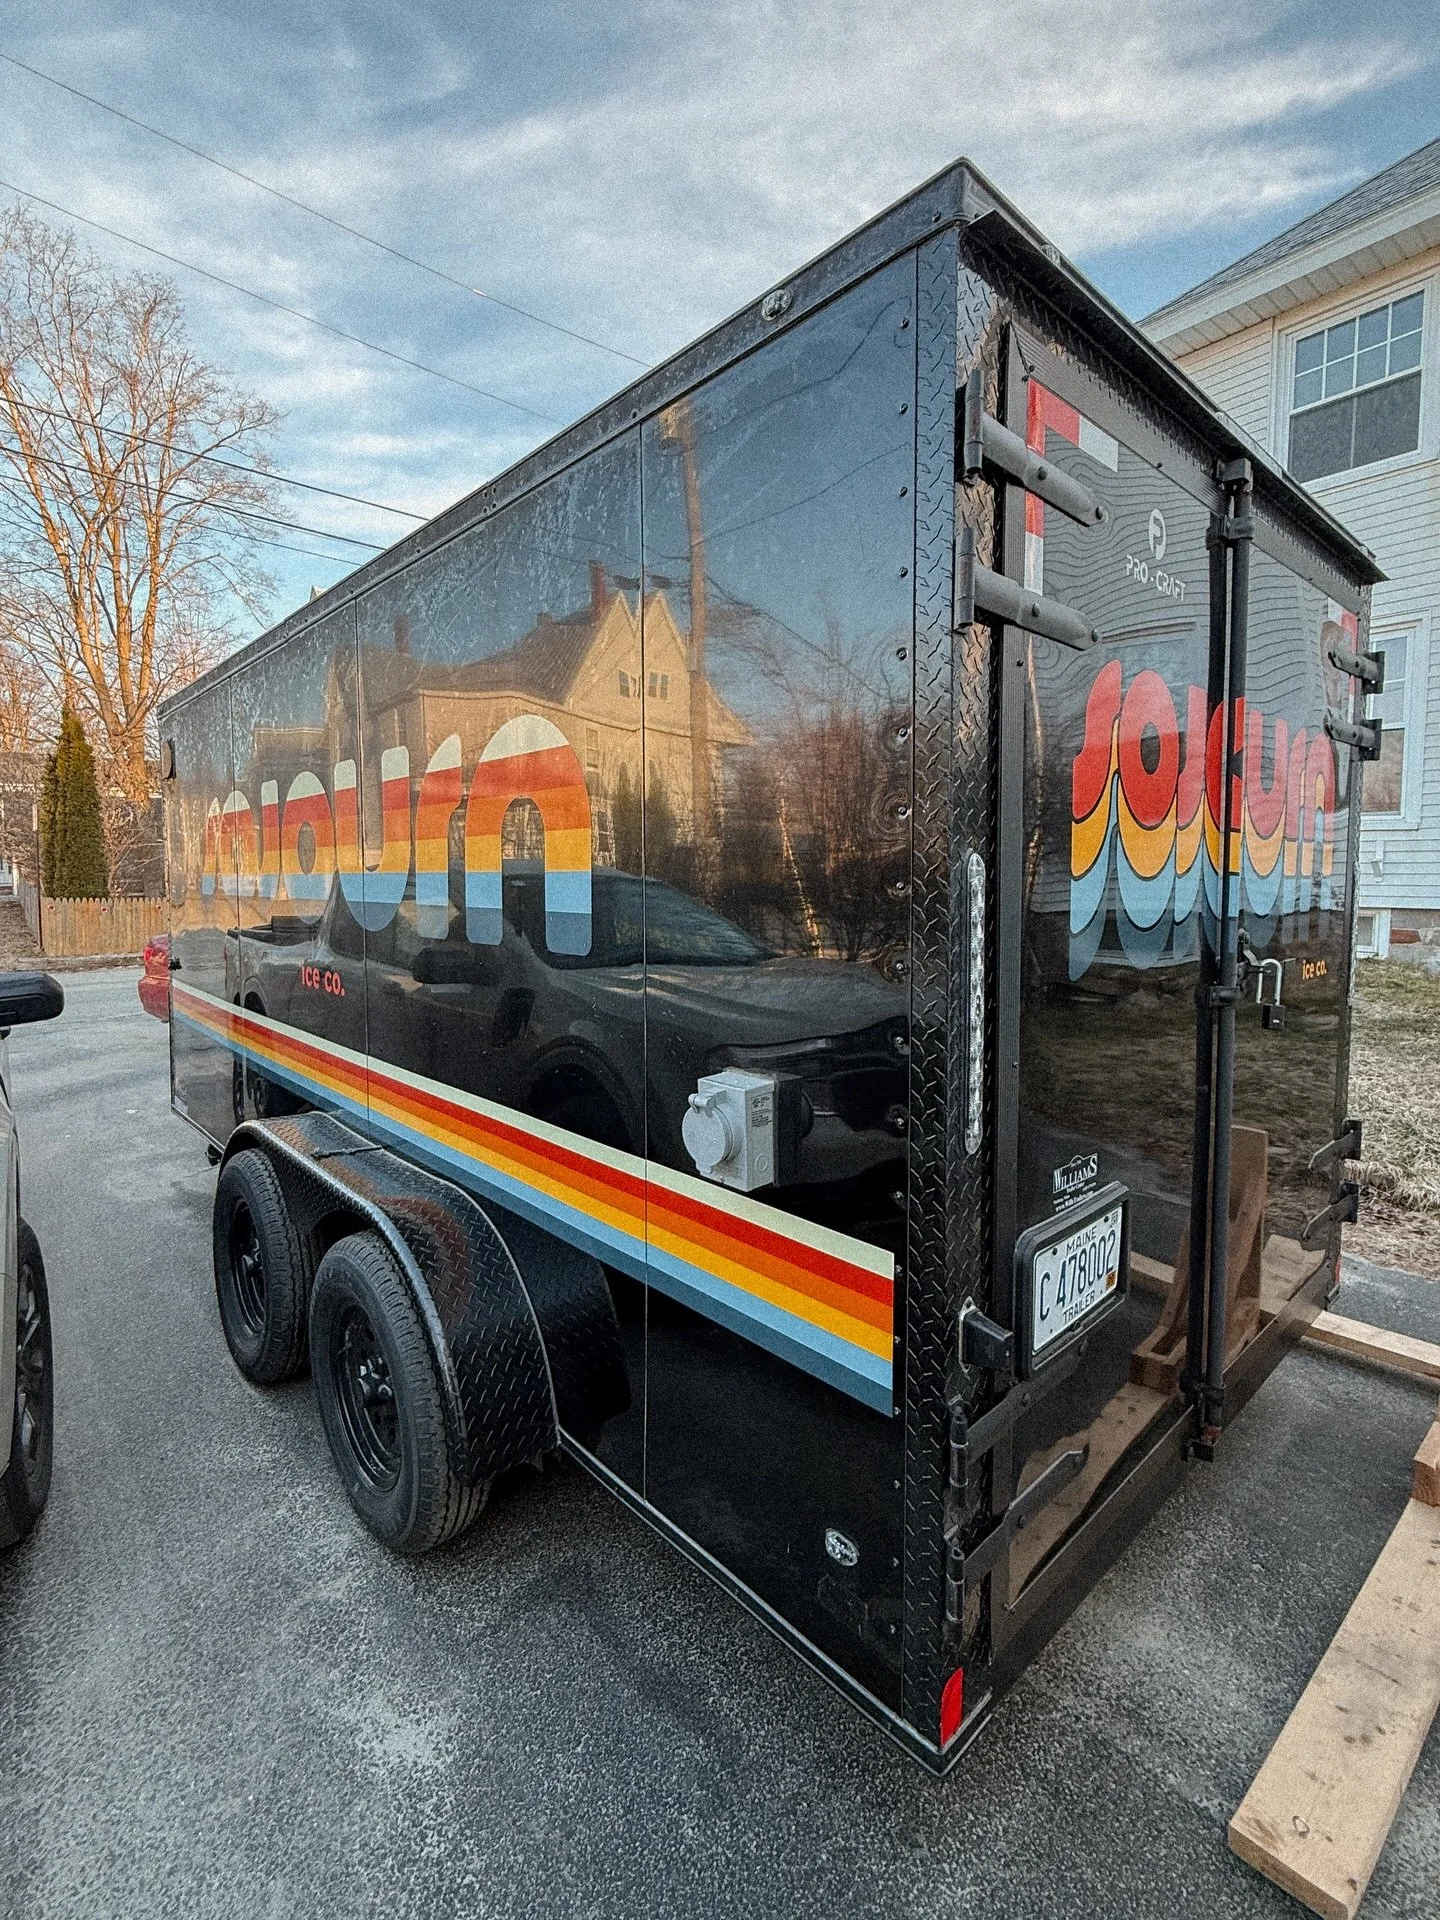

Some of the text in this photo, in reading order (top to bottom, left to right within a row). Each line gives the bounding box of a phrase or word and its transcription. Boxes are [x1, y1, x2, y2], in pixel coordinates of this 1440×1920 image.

[301, 960, 345, 996] ice co.
[1302, 959, 1328, 980] ice co.
[1054, 1155, 1098, 1191] WILLIAMS
[1066, 1225, 1097, 1257] MAINE
[1040, 1229, 1116, 1322] C 478002
[1063, 1290, 1096, 1325] TRAILER
